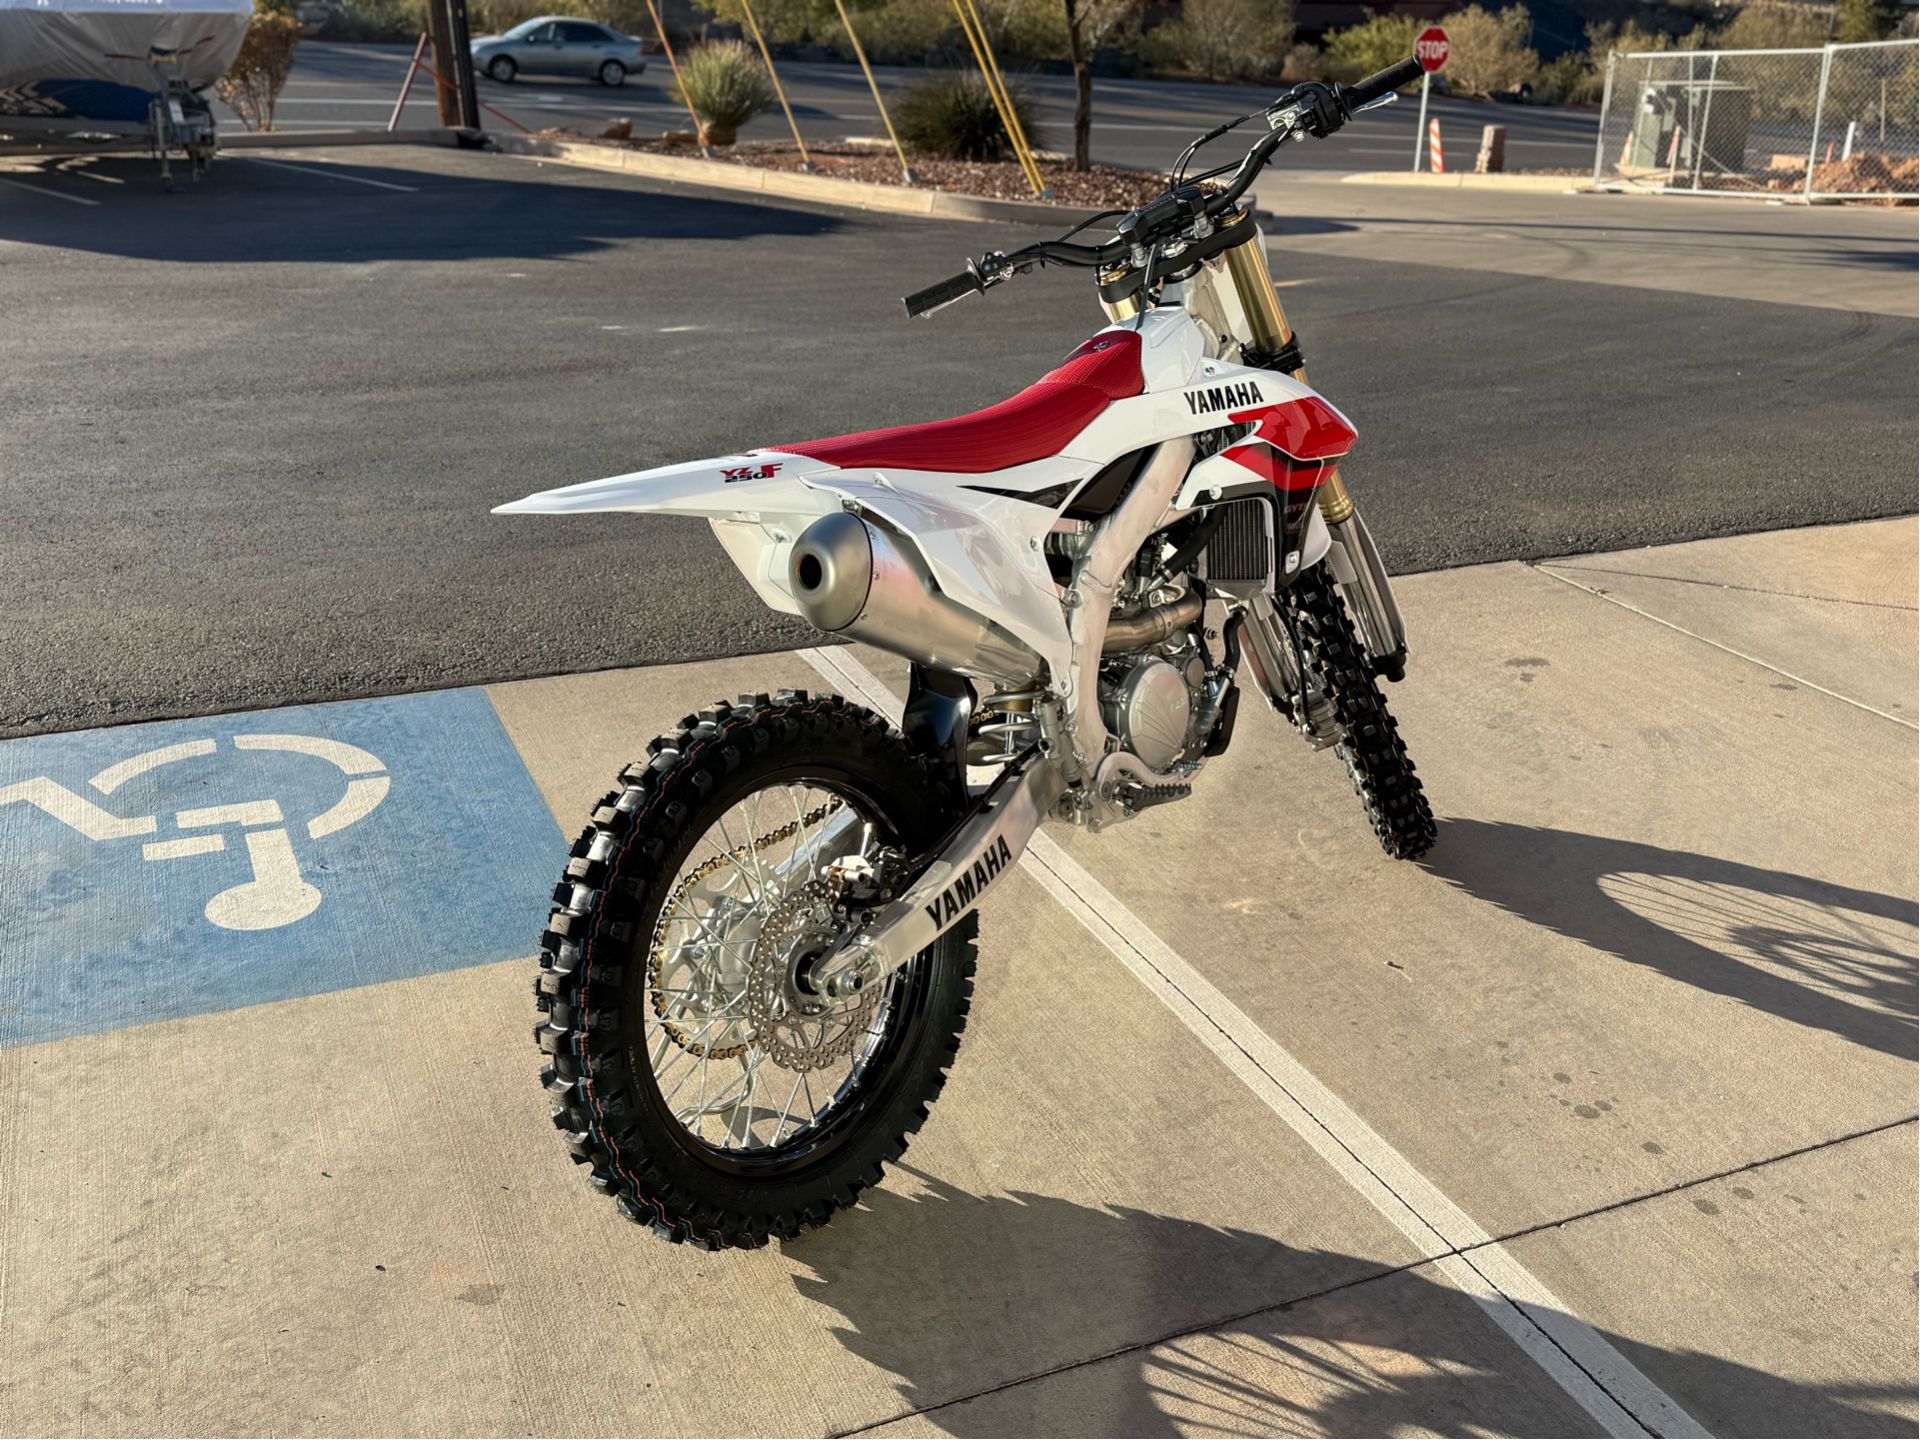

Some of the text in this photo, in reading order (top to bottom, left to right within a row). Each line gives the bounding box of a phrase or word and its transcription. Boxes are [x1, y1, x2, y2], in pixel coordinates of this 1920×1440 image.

[1417, 41, 1449, 59] STOP
[1184, 381, 1264, 415] YAMAHA
[925, 834, 1012, 932] YAMAHA
